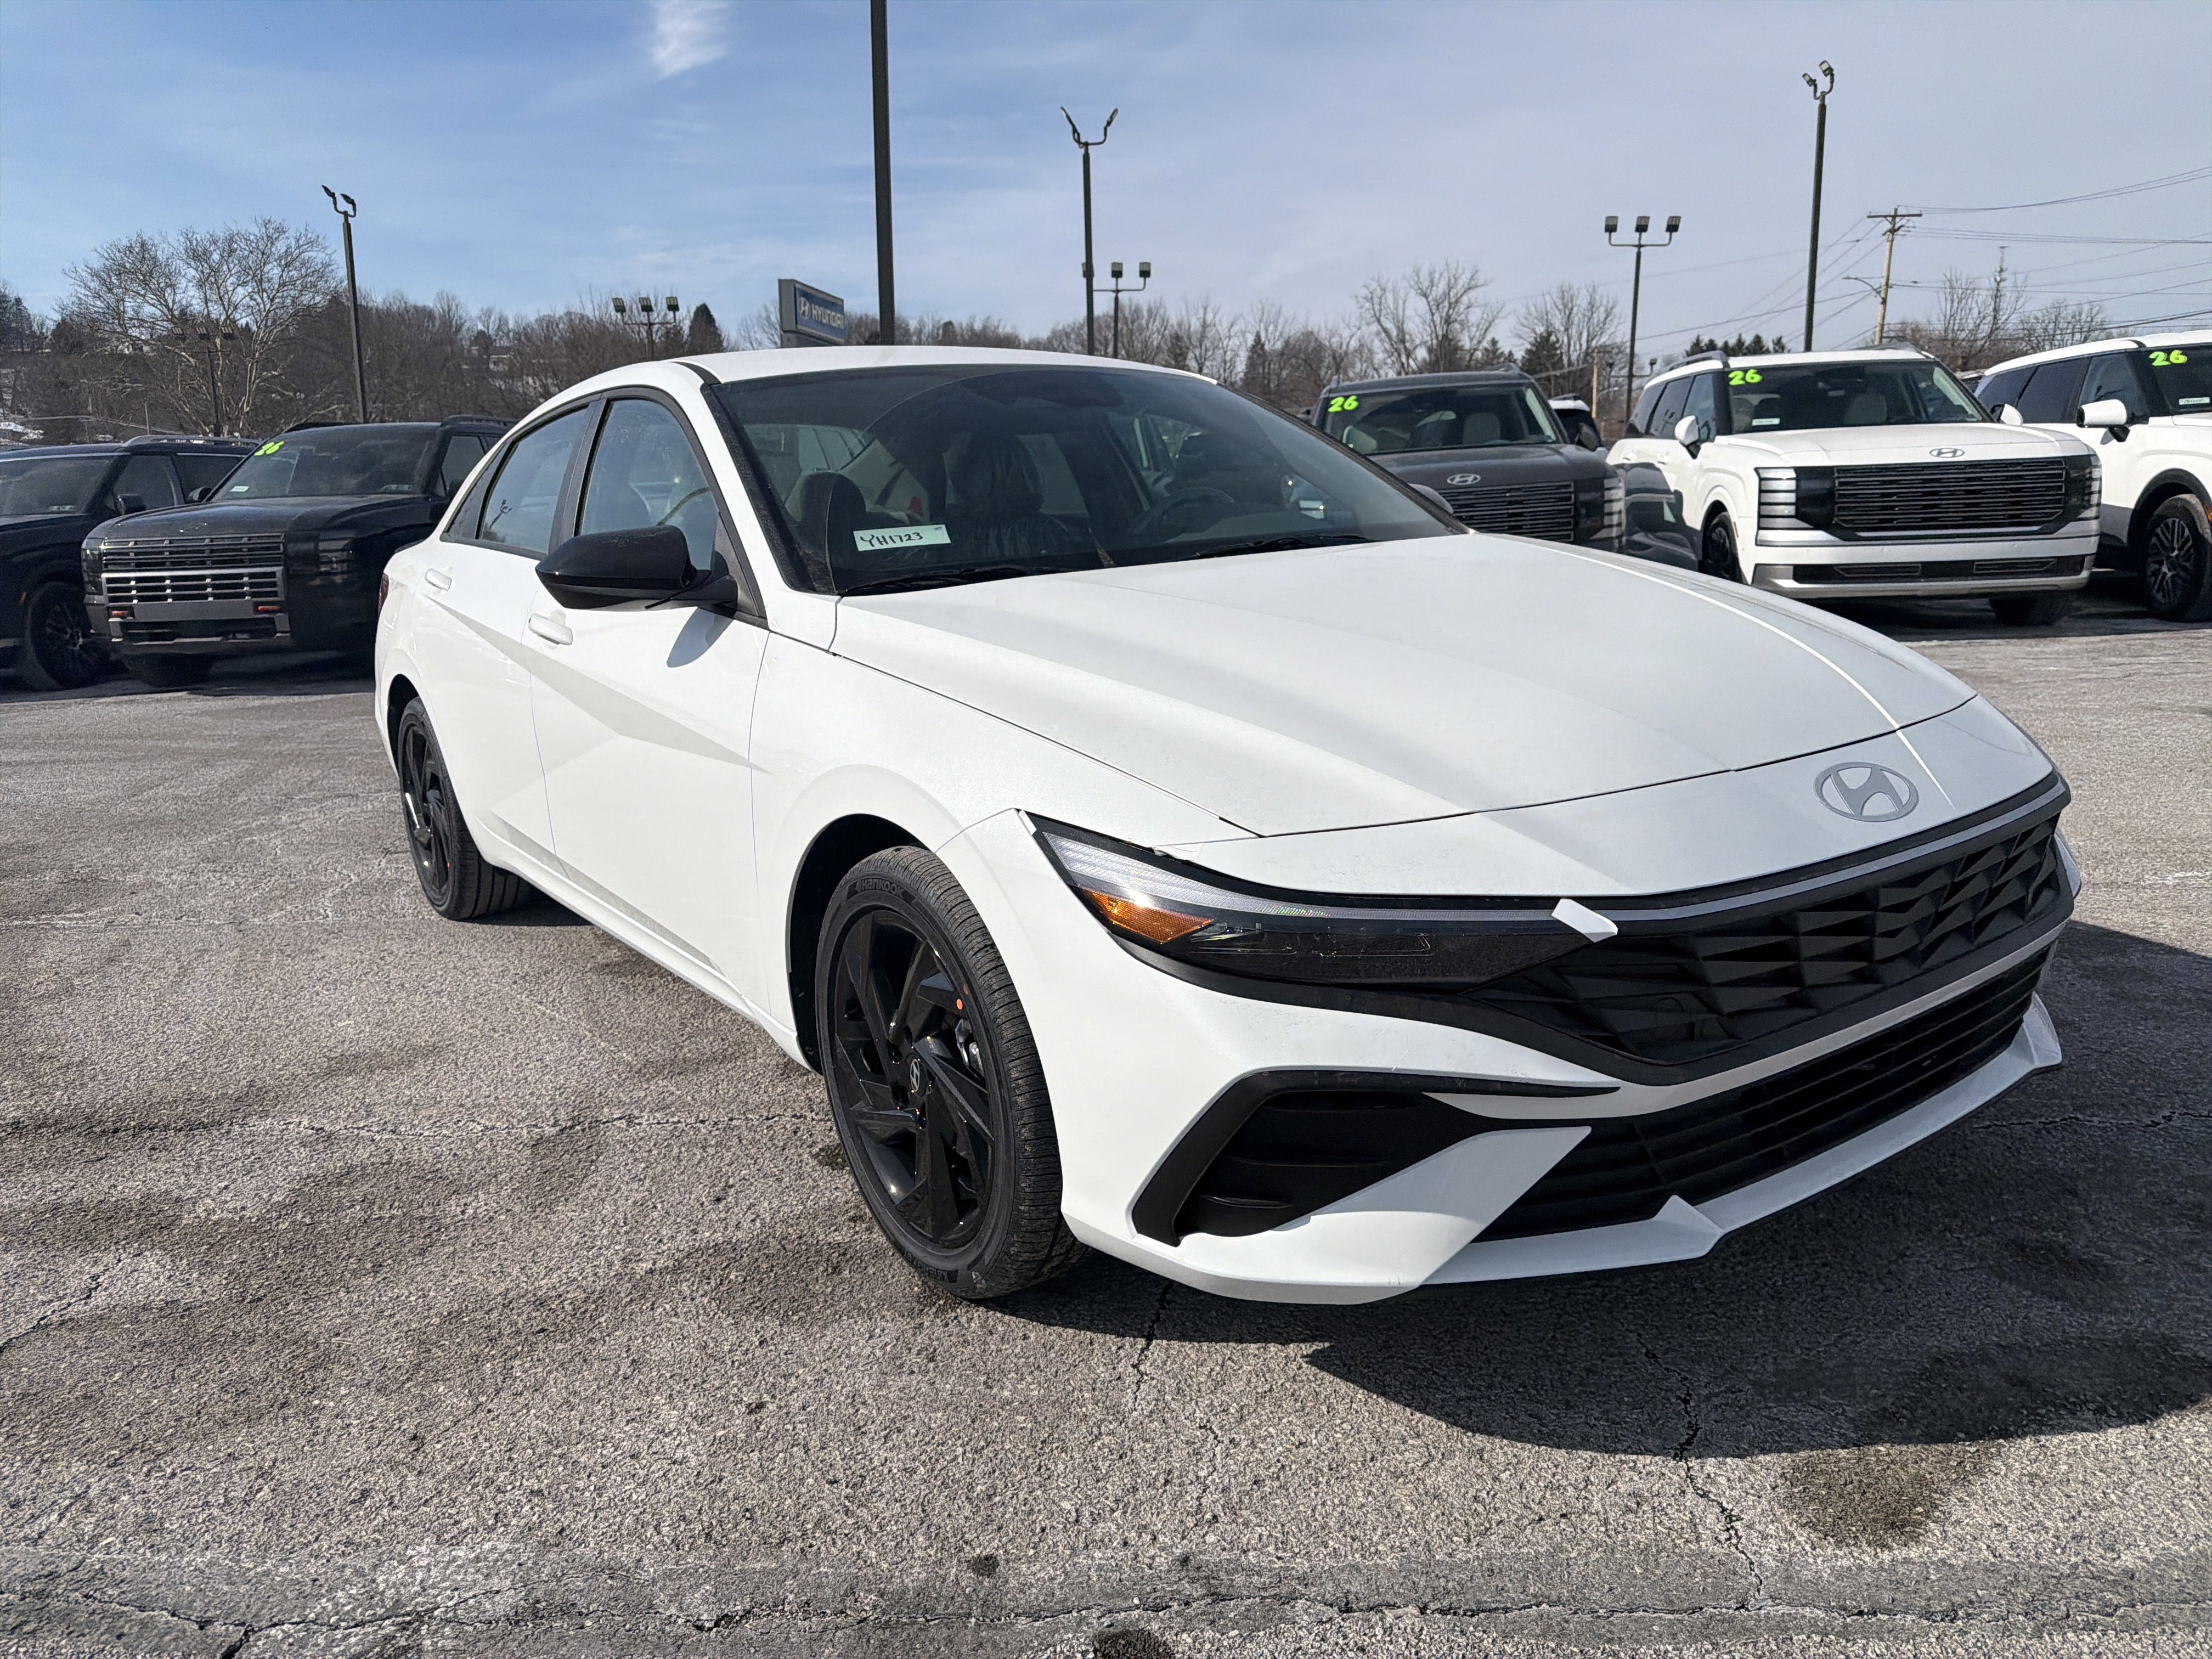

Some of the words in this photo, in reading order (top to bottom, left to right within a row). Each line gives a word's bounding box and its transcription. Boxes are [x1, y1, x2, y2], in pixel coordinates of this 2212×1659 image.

[2149, 350, 2187, 366] 26
[1728, 369, 1763, 386] 26
[1328, 396, 1359, 413] 26
[254, 441, 285, 456] 26
[860, 532, 923, 547] YH1723
